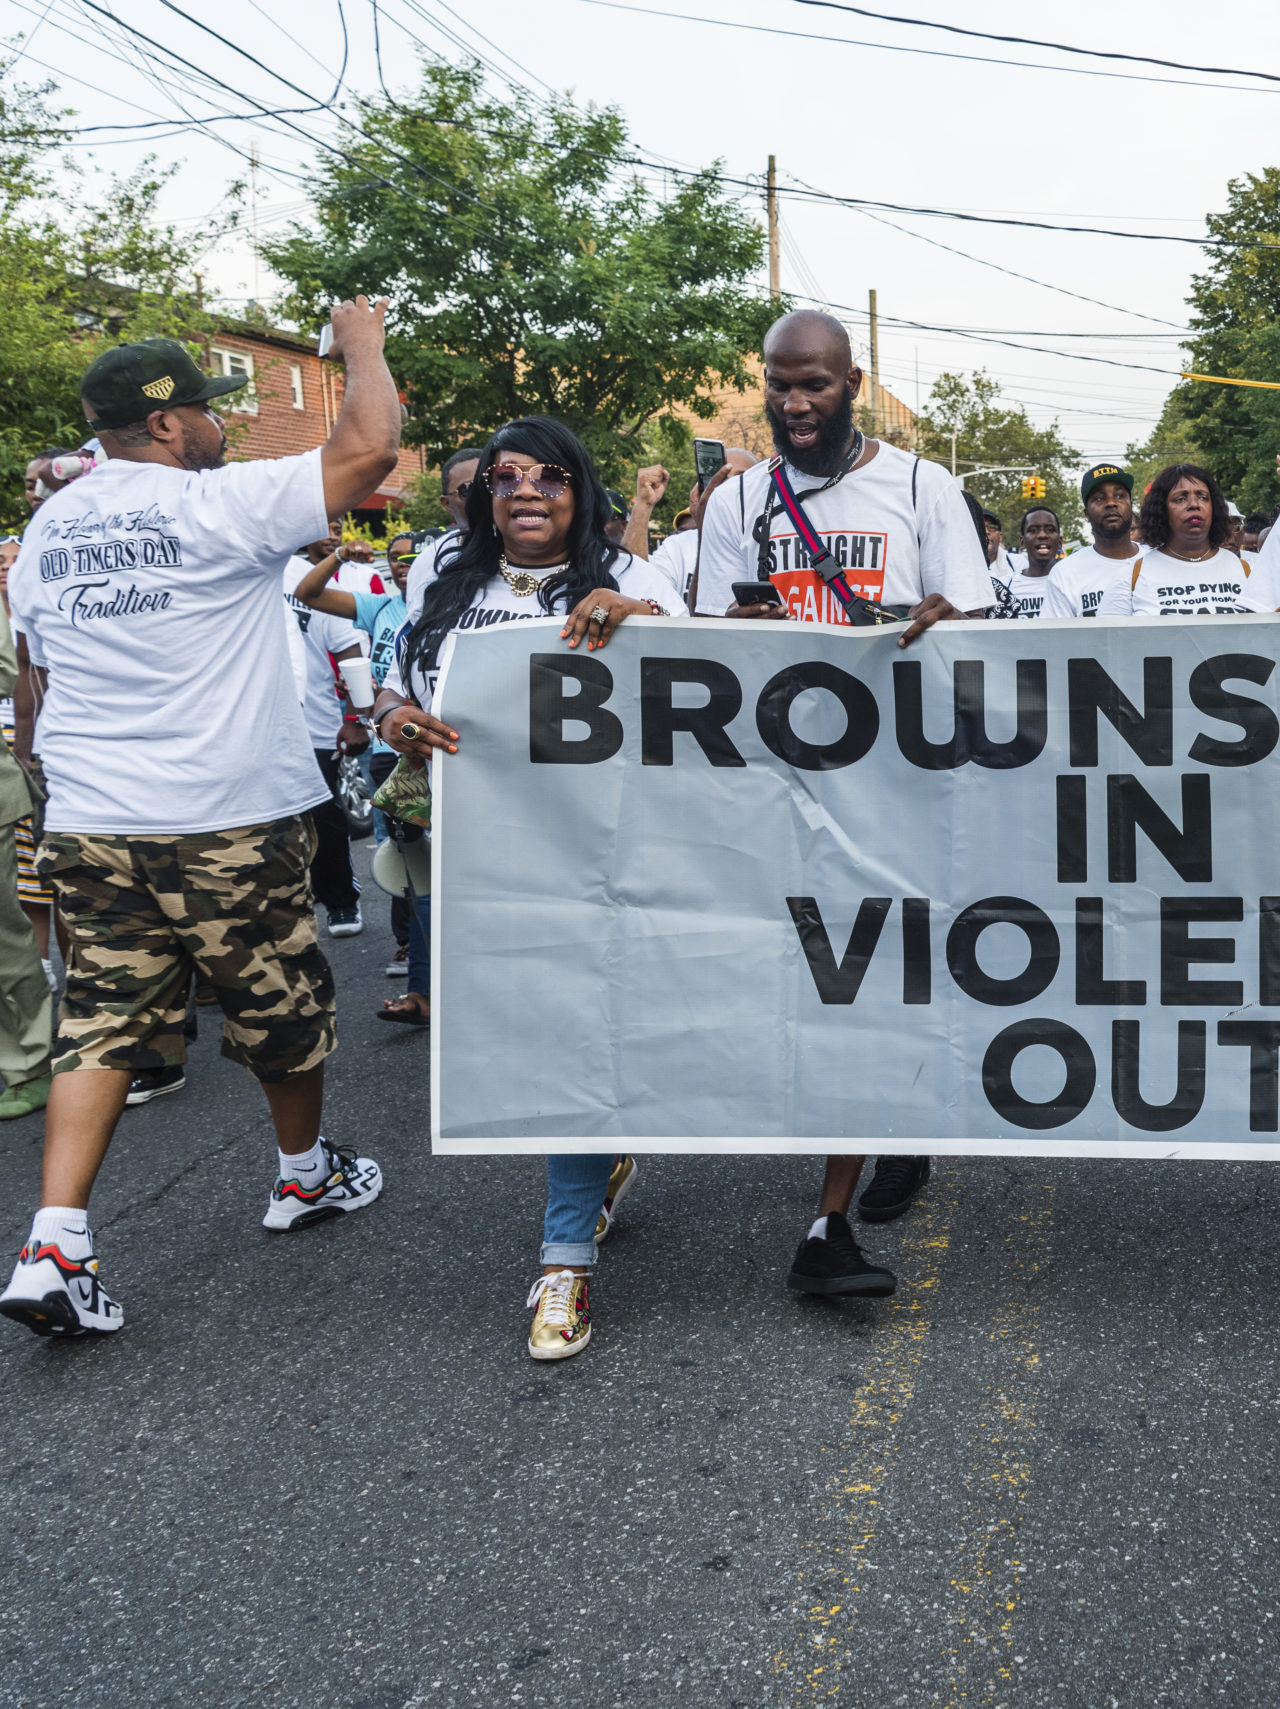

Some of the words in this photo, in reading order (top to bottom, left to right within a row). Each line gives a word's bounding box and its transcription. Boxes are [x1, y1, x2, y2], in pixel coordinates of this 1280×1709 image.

[40, 547, 71, 583] OLD
[72, 539, 138, 576] TIMERS
[140, 536, 182, 568] DAY
[768, 534, 883, 573] STRGHT
[58, 578, 173, 628] Tradition
[777, 584, 882, 624] GAIN
[1157, 585, 1196, 598] STOP
[1199, 582, 1242, 595] DYING
[1182, 596, 1209, 606] YOUR
[1056, 774, 1213, 883] IN
